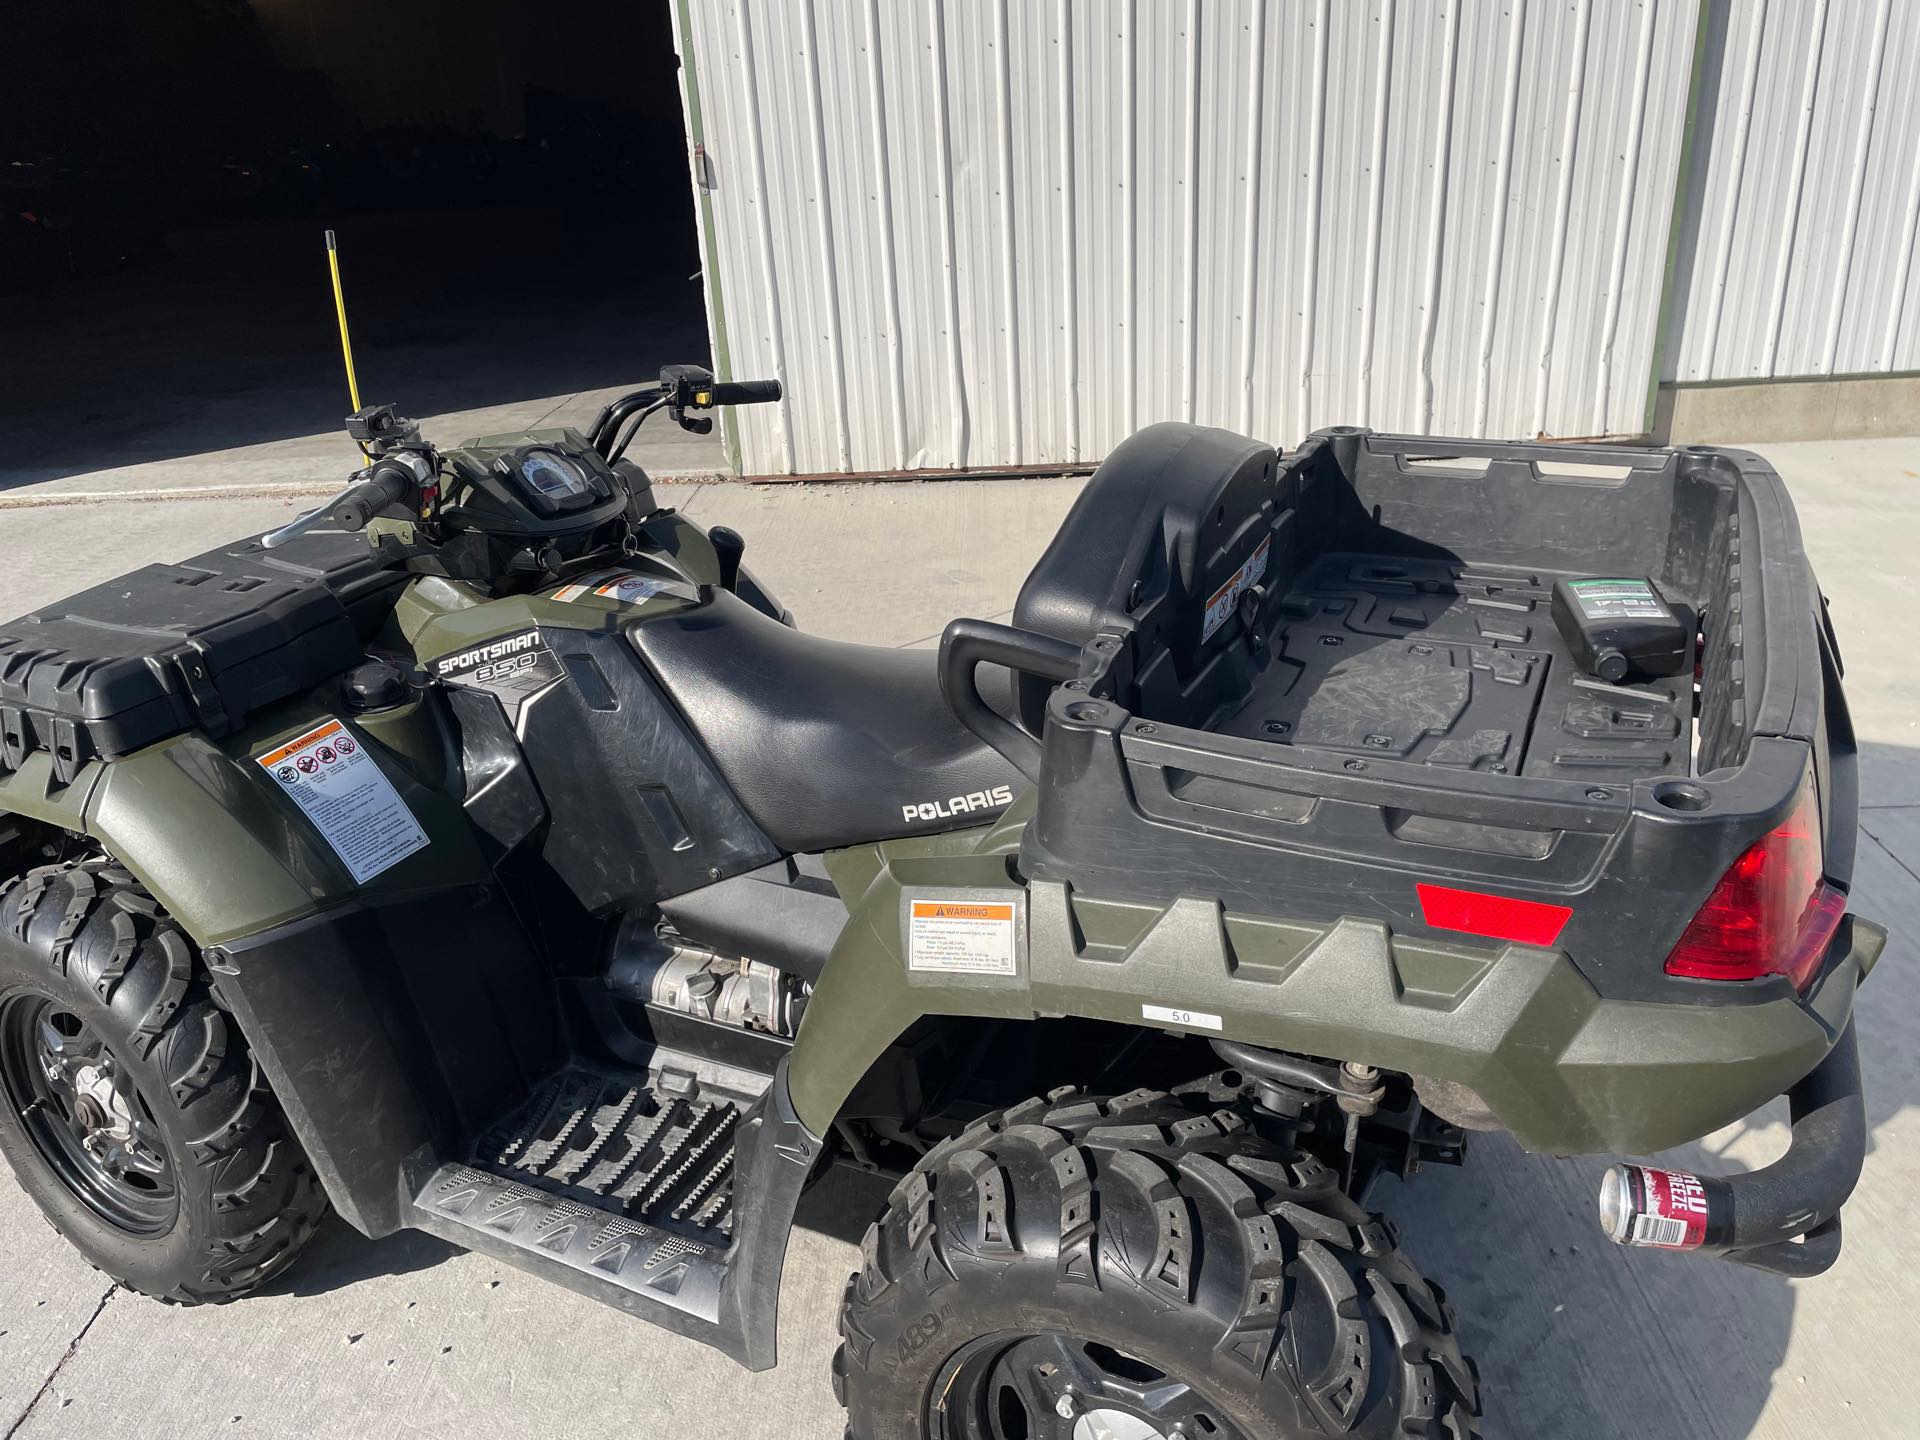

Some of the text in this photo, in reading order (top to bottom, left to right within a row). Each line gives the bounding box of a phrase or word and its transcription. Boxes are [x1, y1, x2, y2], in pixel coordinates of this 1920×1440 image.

[438, 631, 540, 675] SPORTSMAN
[475, 651, 537, 682] 850
[291, 733, 322, 752] WARNING
[902, 784, 1013, 822] POLARIS
[946, 907, 988, 916] WARNING
[1172, 1011, 1190, 1022] 5.0
[1666, 1172, 1688, 1211] FREEZE
